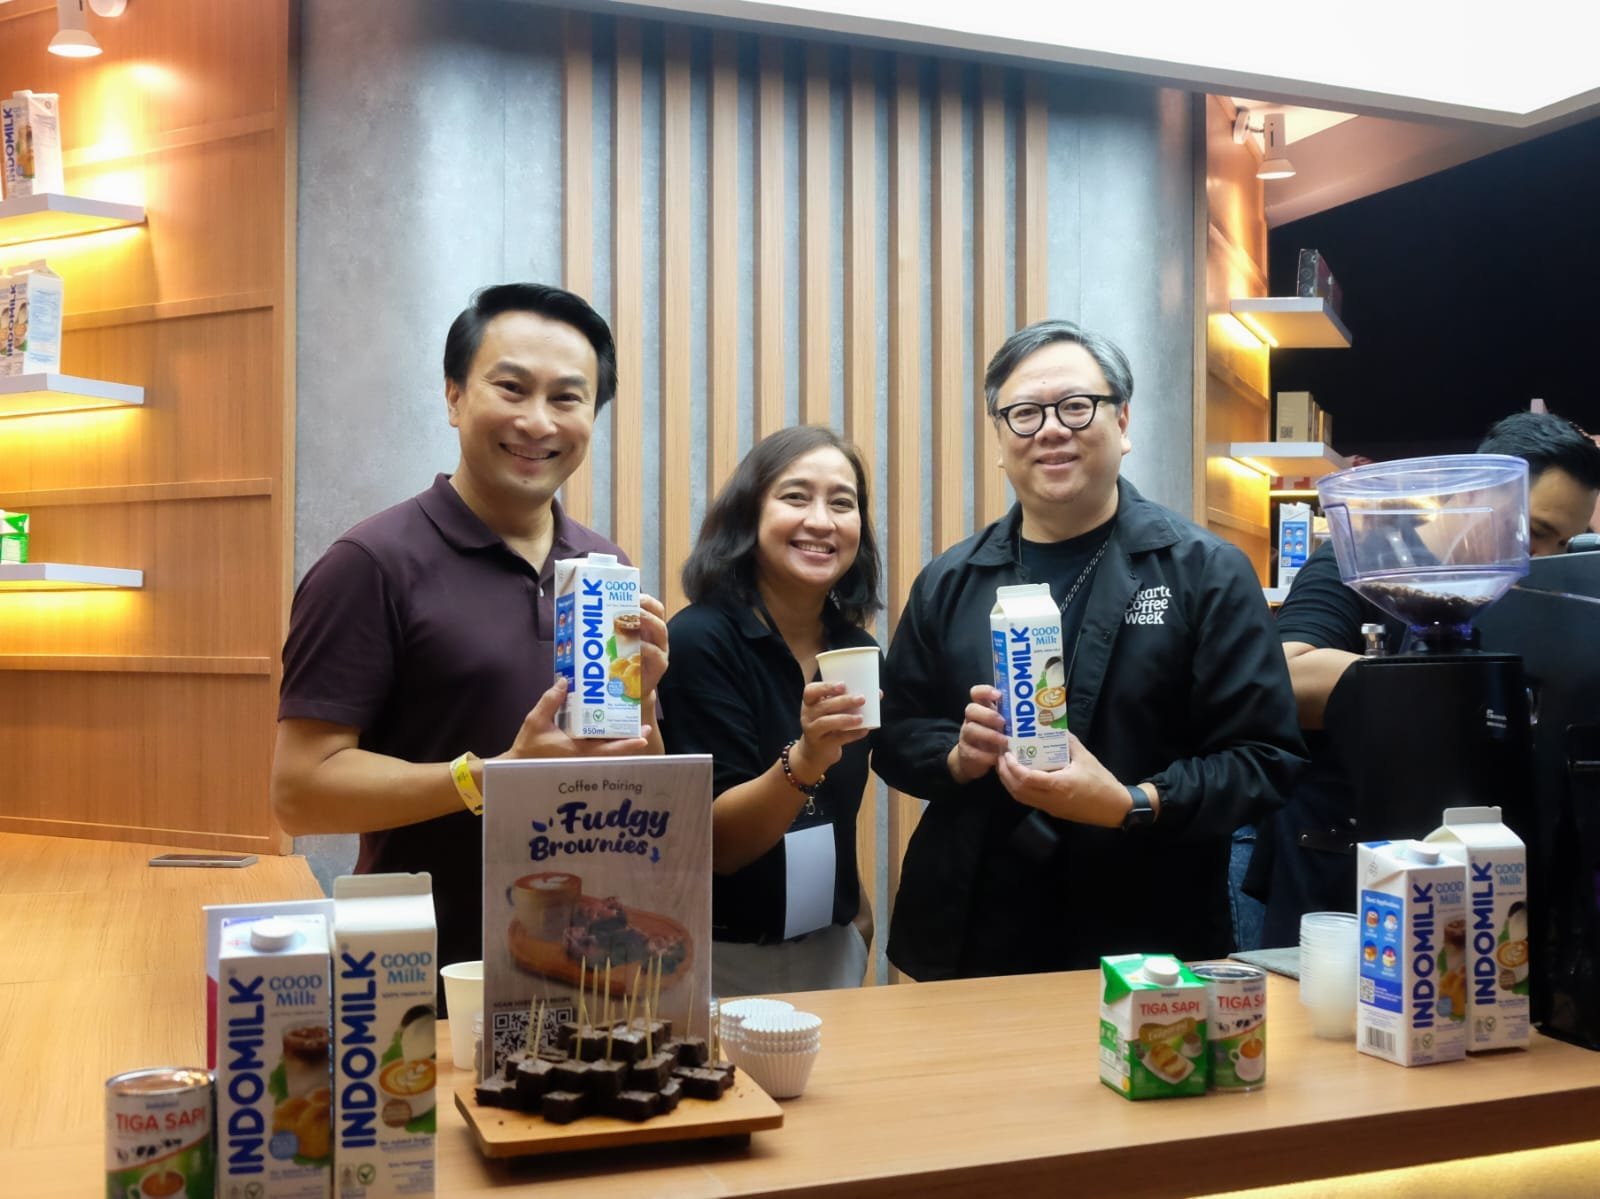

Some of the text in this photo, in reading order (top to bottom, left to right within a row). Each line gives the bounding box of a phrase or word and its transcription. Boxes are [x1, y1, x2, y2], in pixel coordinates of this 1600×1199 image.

[605, 581, 636, 591] GOOD
[609, 591, 633, 602] Milk
[1031, 626, 1060, 636] GOOD
[582, 578, 605, 704] INDOMILK
[1036, 636, 1057, 646] Milk
[1010, 626, 1036, 738] INDOMILK
[583, 726, 605, 735] 950ml
[558, 778, 643, 794] Coffee Pairing
[557, 798, 670, 838] Fudgy
[529, 831, 648, 861] Brownies
[1495, 863, 1524, 874] GOOD
[1436, 881, 1464, 893] GOOD
[1471, 862, 1496, 1005] INDOMILK
[380, 951, 432, 969] GOOD
[1412, 882, 1434, 1028] INDOMILK
[269, 974, 322, 991] GOOD
[387, 968, 427, 985] Milk
[275, 991, 317, 1007] Milk
[1217, 995, 1251, 1009] TIGA
[1140, 1001, 1199, 1016] TIGA SAPI
[340, 950, 377, 1148] INDOMILK
[228, 974, 264, 1174] INDOMILK
[116, 1106, 206, 1132] TIGA SAPI
